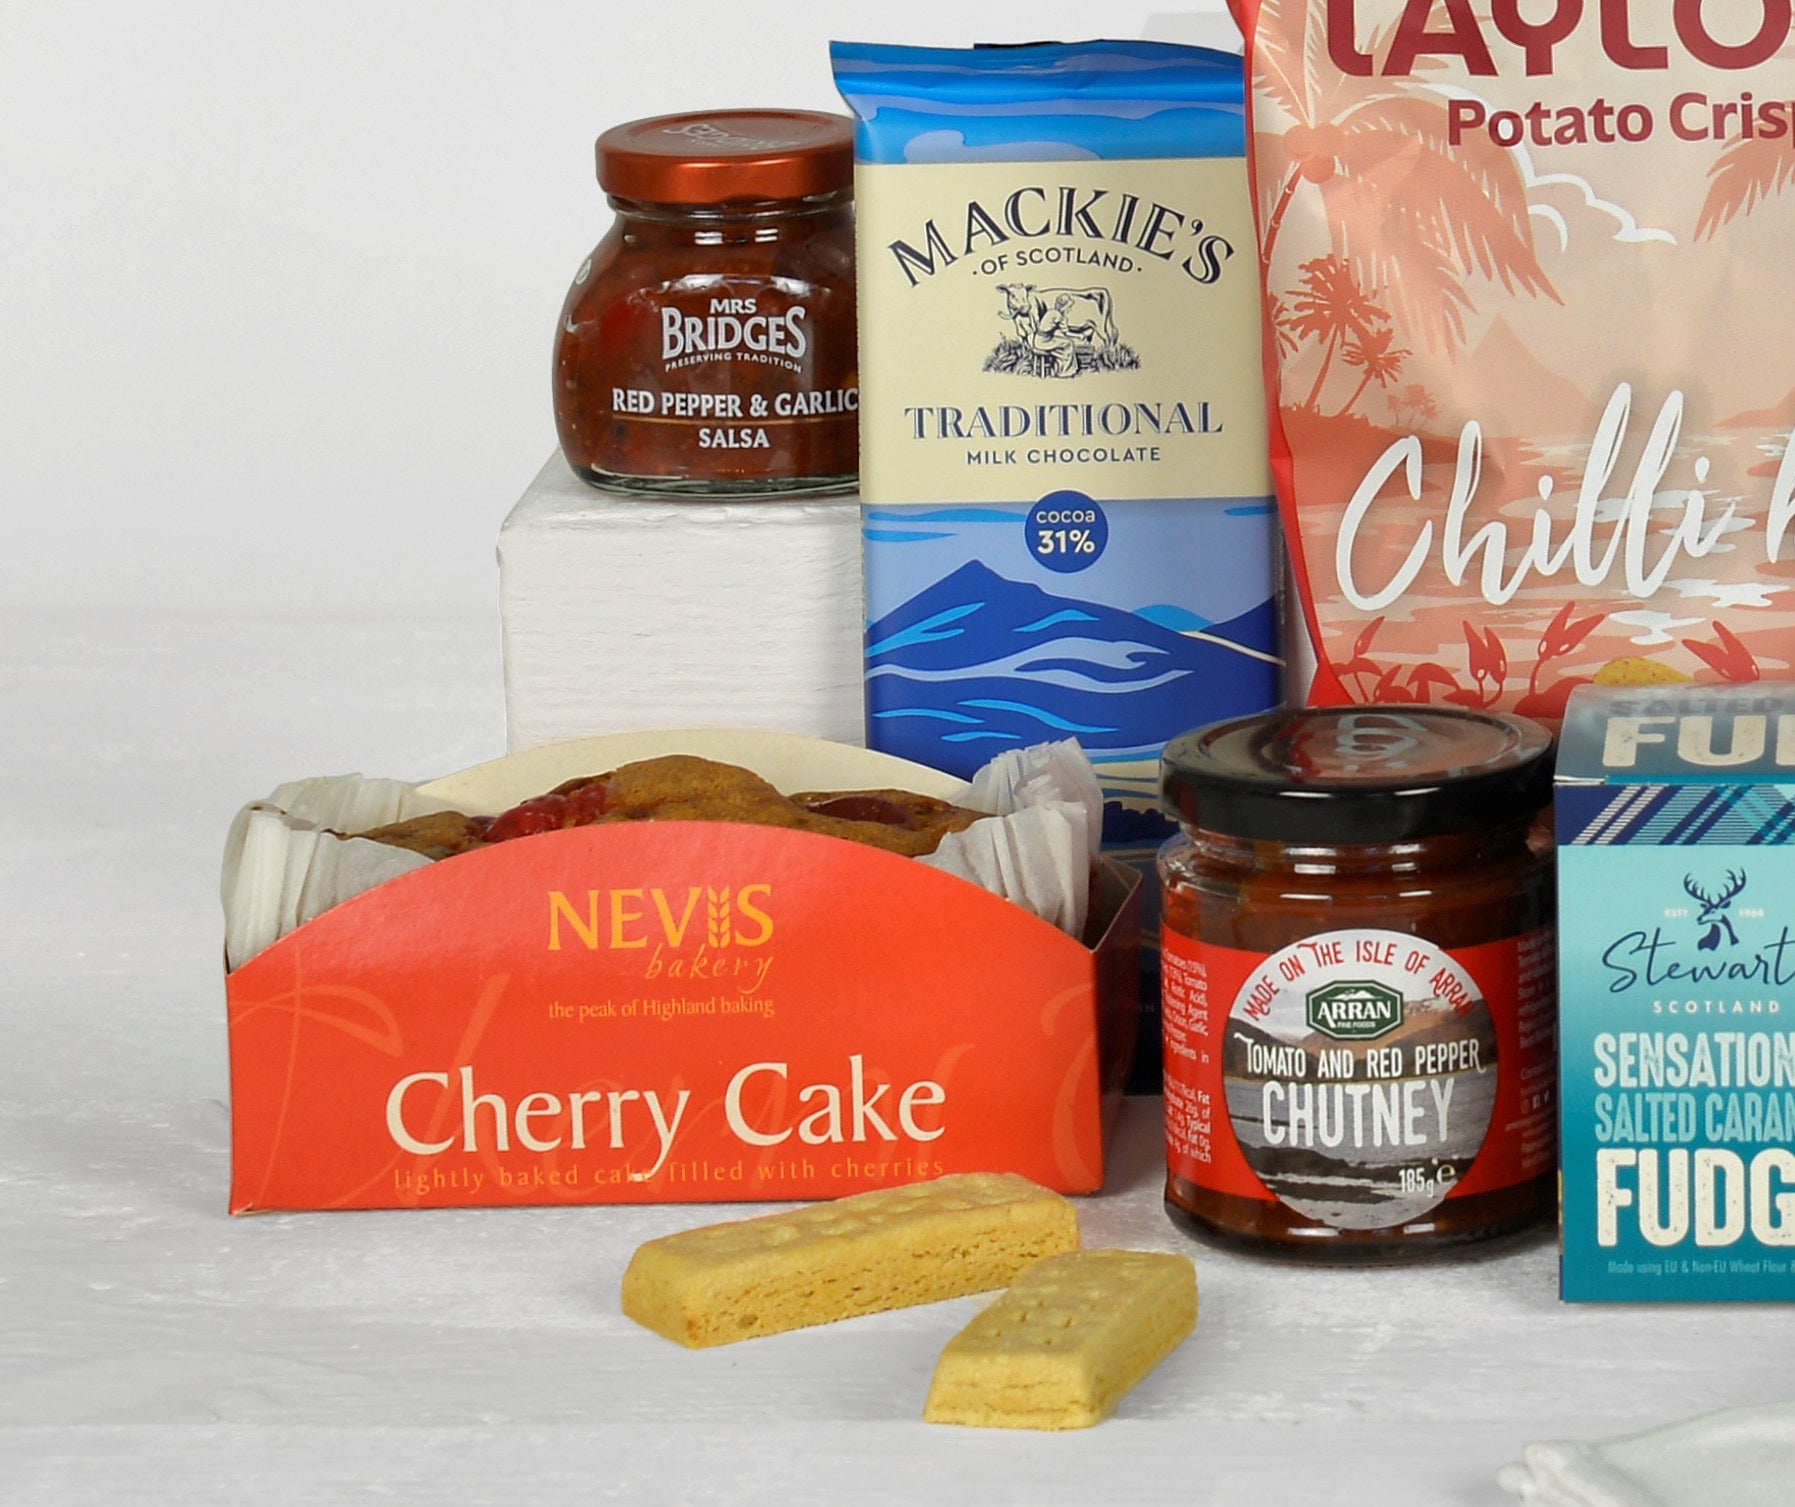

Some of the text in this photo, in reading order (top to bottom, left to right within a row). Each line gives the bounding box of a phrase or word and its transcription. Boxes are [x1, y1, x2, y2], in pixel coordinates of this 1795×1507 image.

[1447, 91, 1795, 148] Potato Cris
[887, 186, 1236, 288] MACKIE'S
[981, 247, 1134, 276] OF SCOTLAND
[709, 298, 757, 314] MRS
[661, 306, 807, 360] BRIDGES
[665, 351, 803, 374] PRESERVING TRADITION
[612, 387, 859, 418] RED PEPPER & GARLIC
[904, 402, 1223, 439] TRADITIONAL
[698, 427, 771, 449] SALSA
[967, 446, 1161, 465] MILK CHOCOLATE
[1336, 382, 1736, 611] Chilli
[1036, 509, 1096, 524] cocoa
[1037, 530, 1096, 555] 31%
[1602, 714, 1795, 767] FU
[547, 884, 774, 950] NEVIS
[645, 942, 775, 994] bakery
[1602, 926, 1795, 993] Stewart
[1243, 940, 1475, 1021] MADE ON THE ISLE OF ARRAN
[549, 996, 775, 1023] the peak of Highland baking
[1317, 1000, 1391, 1028] ARRAN
[1653, 1000, 1780, 1014] SCOTLAND
[1233, 1032, 1307, 1077] TOMATO
[1317, 1049, 1354, 1079] AND
[1366, 1048, 1403, 1078] RED
[1415, 1038, 1487, 1075] PEPPER
[385, 1054, 946, 1182] Cherry Cake
[1262, 1078, 1455, 1149] CHUTNEY
[1595, 1092, 1697, 1143] SALTED
[394, 1168, 484, 1195] lightly
[500, 1165, 578, 1187] baked
[669, 1160, 744, 1182] filled
[757, 1159, 815, 1180] with
[831, 1158, 944, 1178] cherries
[1398, 1167, 1434, 1198] 185g
[1596, 1148, 1795, 1247] FUDG
[1607, 1260, 1634, 1274] Made
[1637, 1261, 1662, 1276] using
[1664, 1260, 1678, 1273] EU
[1681, 1260, 1689, 1273] &
[1692, 1260, 1726, 1273] Non-EU
[1728, 1260, 1760, 1273] Wheat
[1763, 1259, 1786, 1273] Flour
